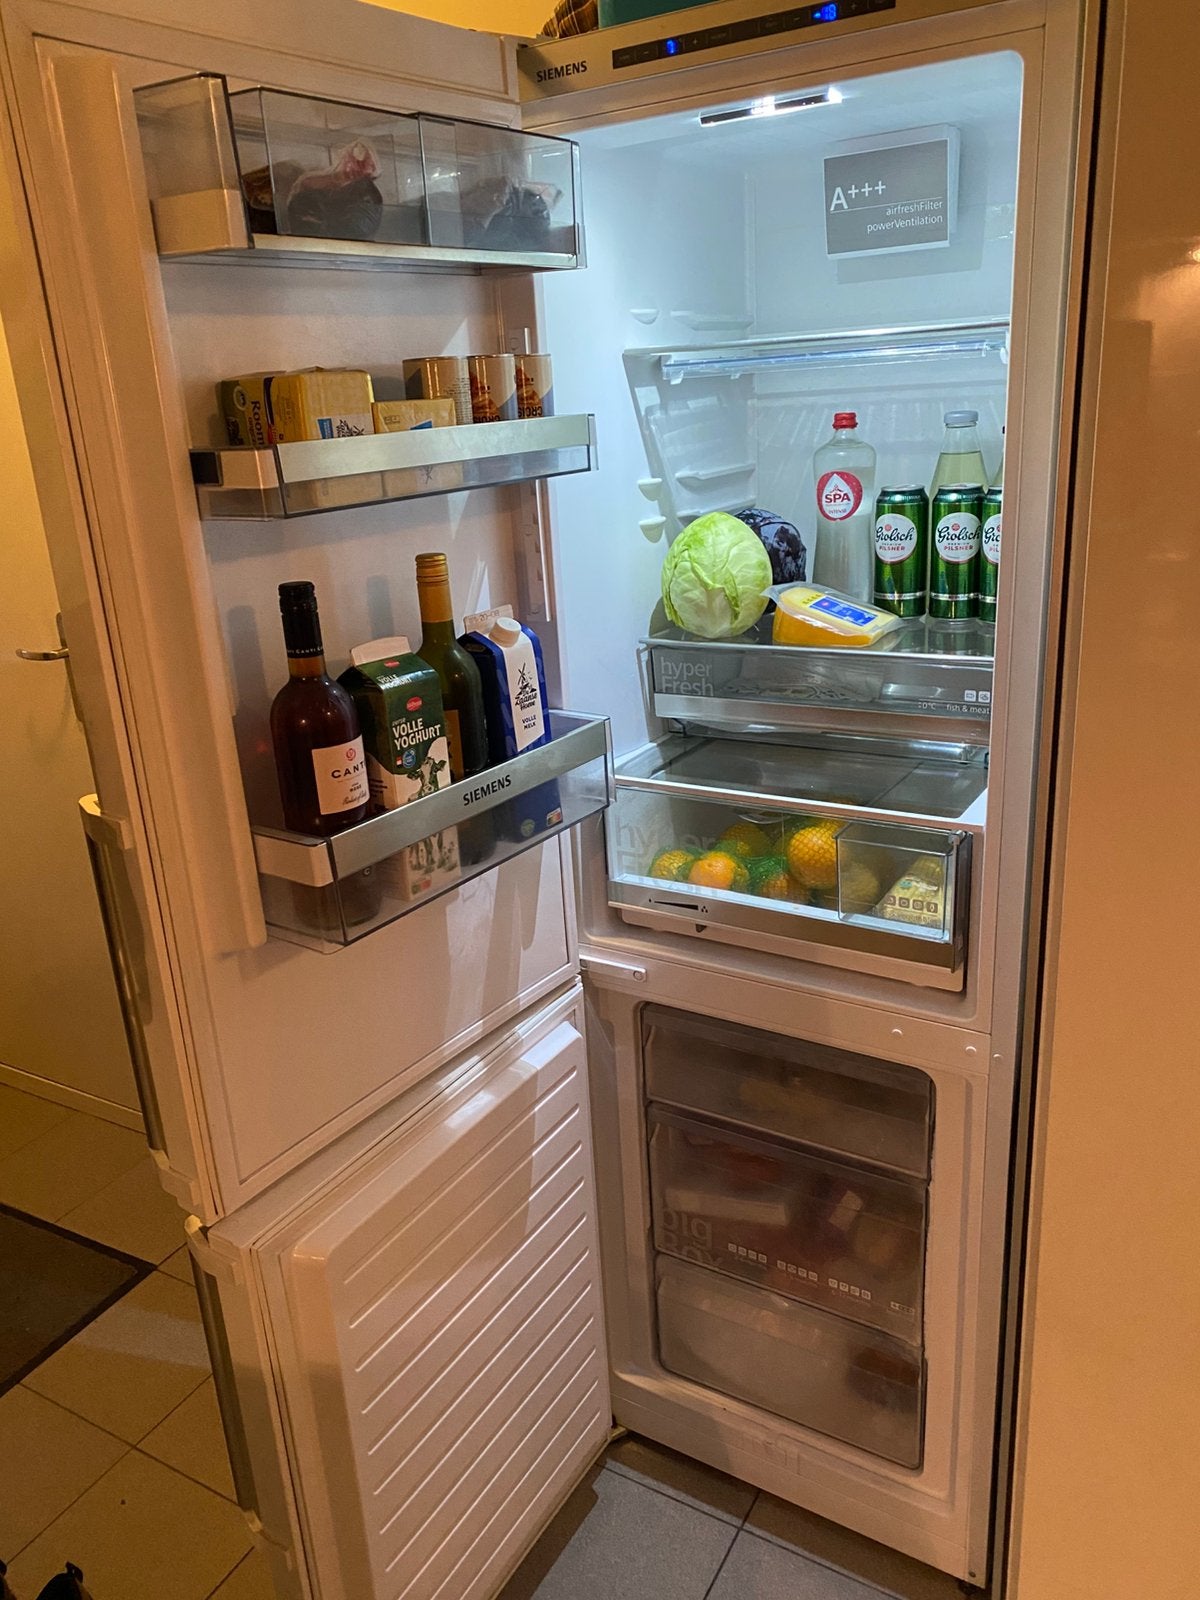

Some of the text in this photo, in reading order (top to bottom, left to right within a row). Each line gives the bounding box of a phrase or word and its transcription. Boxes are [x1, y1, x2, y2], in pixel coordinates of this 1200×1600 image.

[536, 60, 588, 83] SIEMENS
[830, 180, 886, 211] A+++
[885, 200, 943, 216] airfreshFilter
[866, 214, 943, 234] powerVentilation
[824, 492, 851, 503] SPA
[875, 526, 914, 543] Grolsch
[937, 525, 981, 543] Grolsch
[660, 656, 712, 680] hyper
[661, 675, 714, 697] Fresh
[946, 703, 960, 712] fish
[969, 705, 989, 714] meat
[392, 718, 424, 738] VOLLE
[522, 714, 537, 724] VOLLE
[523, 721, 537, 730] MELK
[394, 724, 442, 751] YOGHURT
[463, 774, 512, 806] SIEMENS
